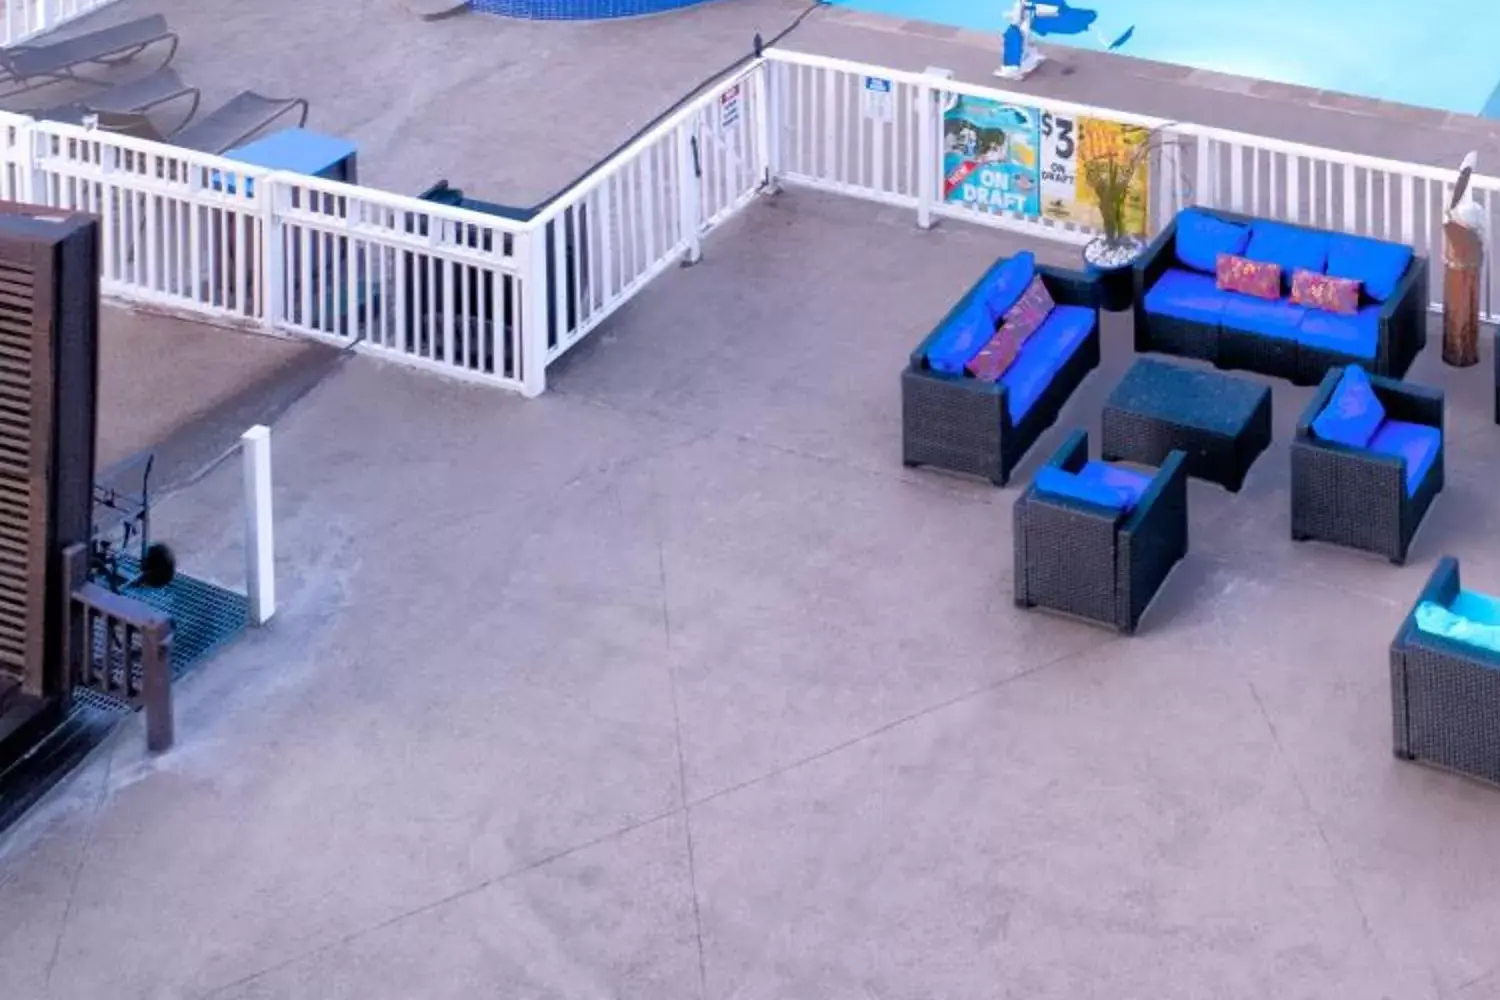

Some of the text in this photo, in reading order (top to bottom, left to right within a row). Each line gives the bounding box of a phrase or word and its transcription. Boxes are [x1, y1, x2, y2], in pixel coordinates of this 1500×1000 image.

[1041, 112, 1075, 160] $3
[1041, 171, 1075, 185] DRAFT
[1050, 162, 1066, 175] ON
[980, 169, 1009, 190] ON
[963, 183, 1027, 211] DRAFT
